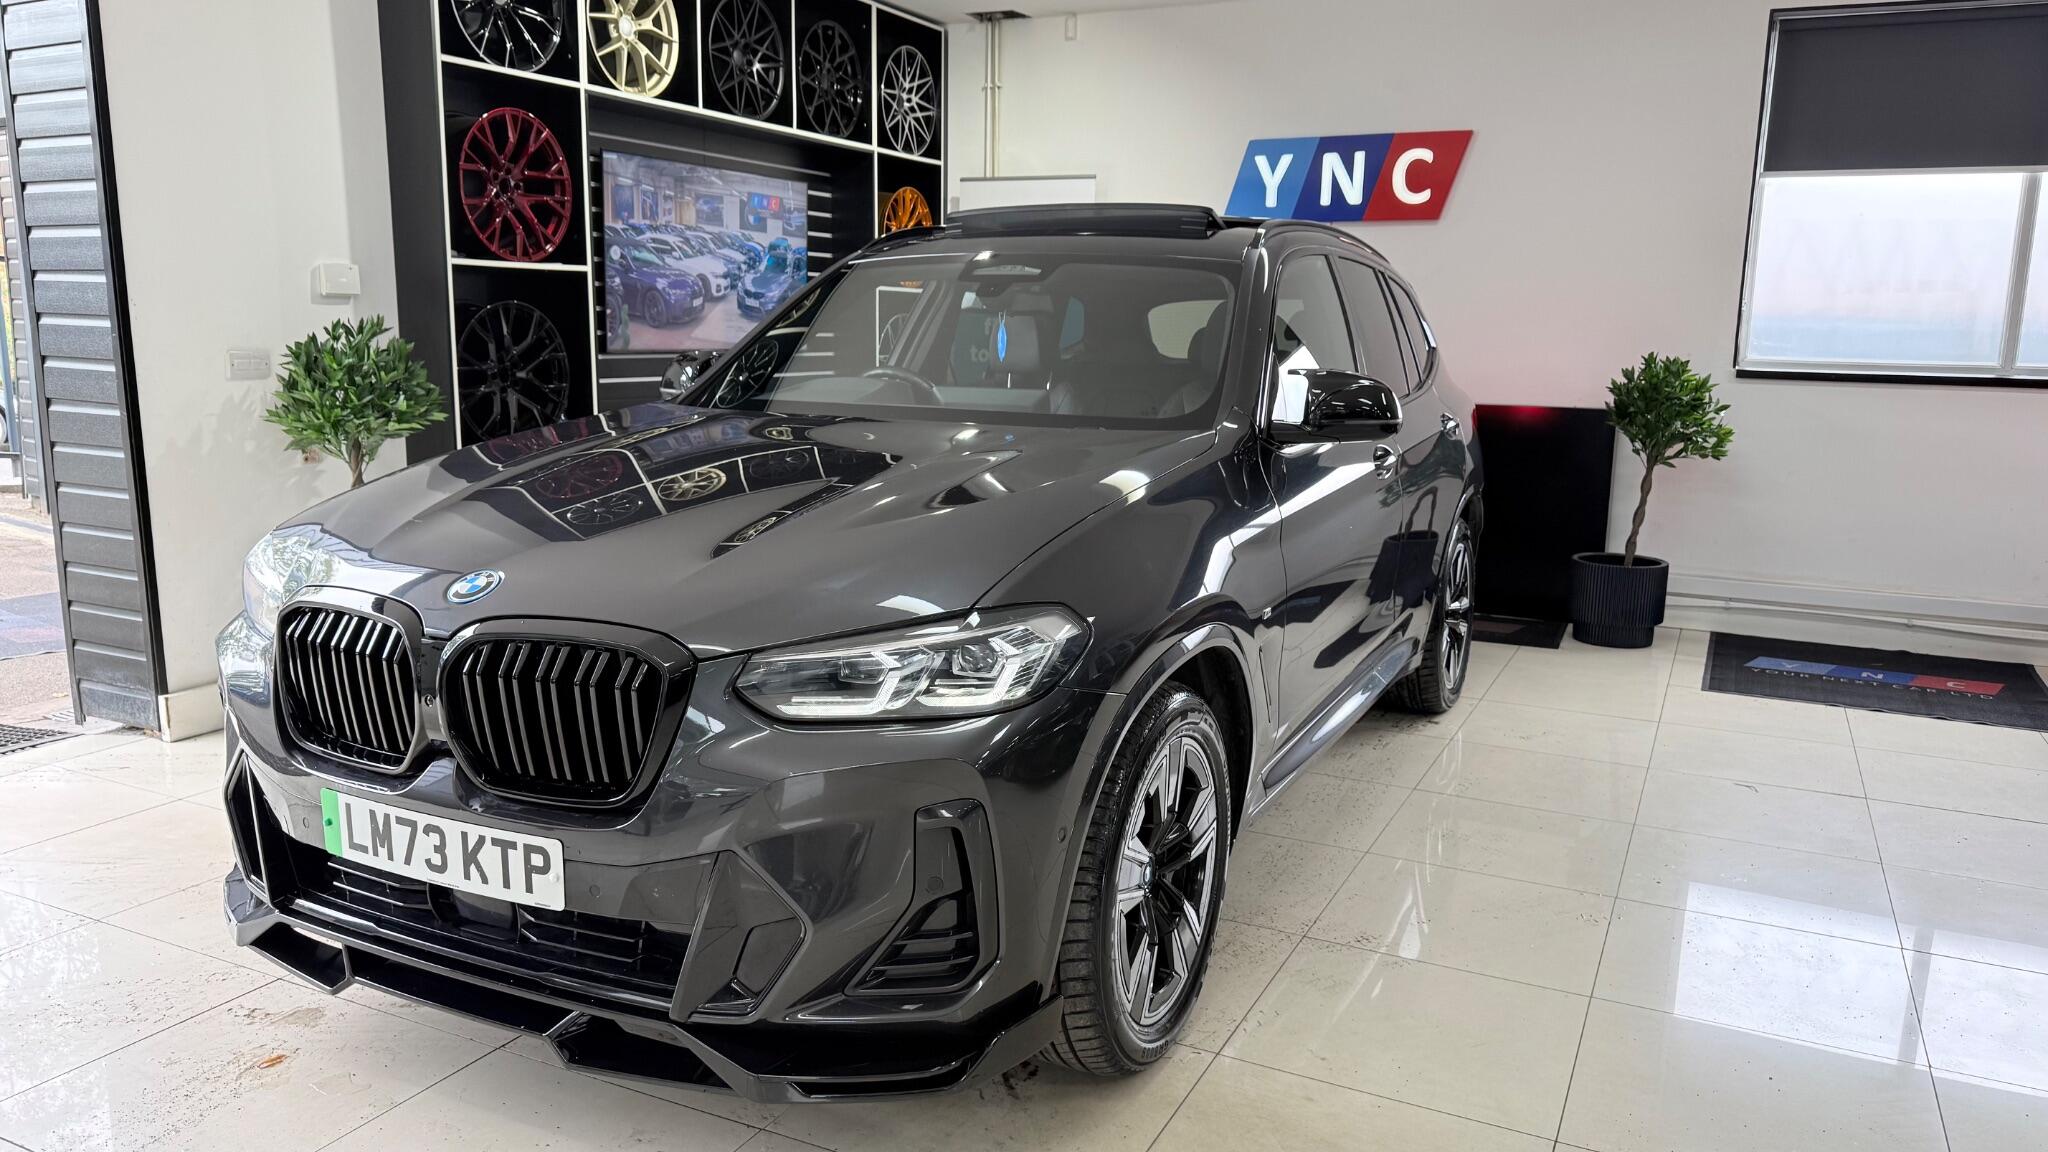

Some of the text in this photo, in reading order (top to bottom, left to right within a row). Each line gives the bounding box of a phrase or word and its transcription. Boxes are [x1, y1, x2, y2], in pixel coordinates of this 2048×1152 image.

[1254, 147, 1434, 208] YNC
[345, 802, 551, 894] LM73 KTP
